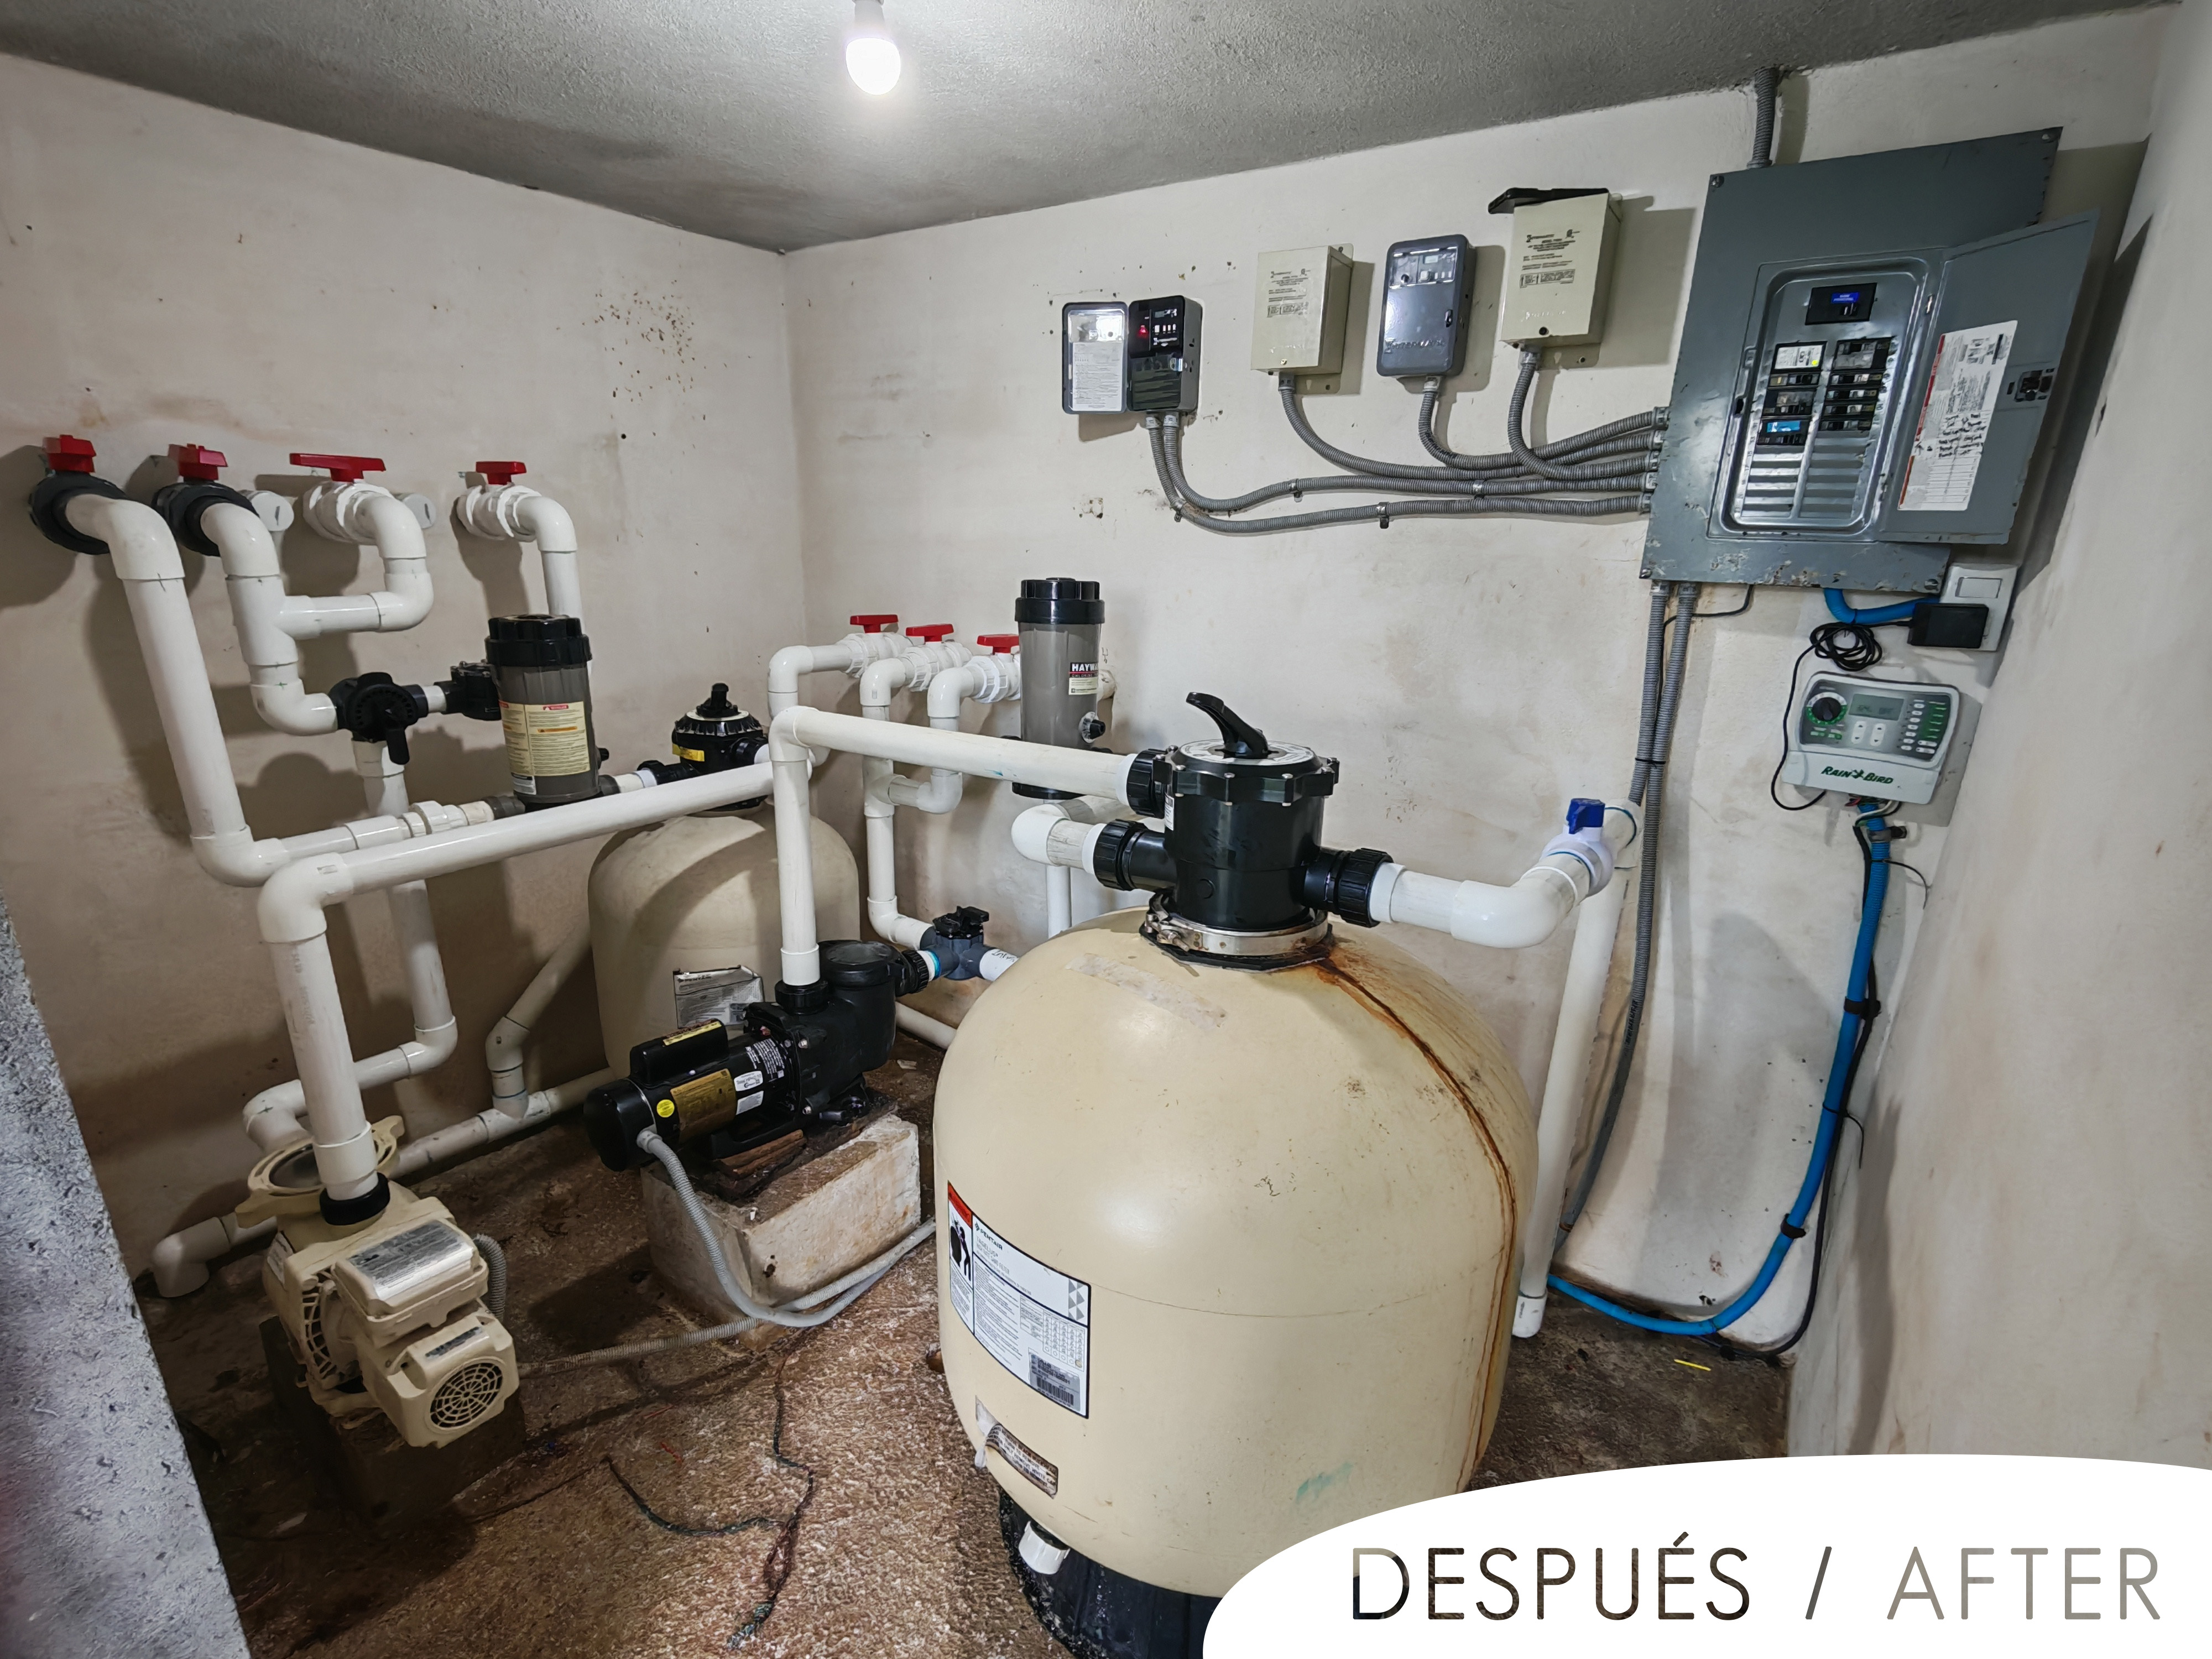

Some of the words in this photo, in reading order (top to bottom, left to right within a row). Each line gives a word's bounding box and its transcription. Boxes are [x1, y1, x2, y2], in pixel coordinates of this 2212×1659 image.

[1821, 766, 1853, 778] RAIN
[1863, 773, 1894, 784] BIRD
[980, 1229, 1003, 1250] PENTAIR
